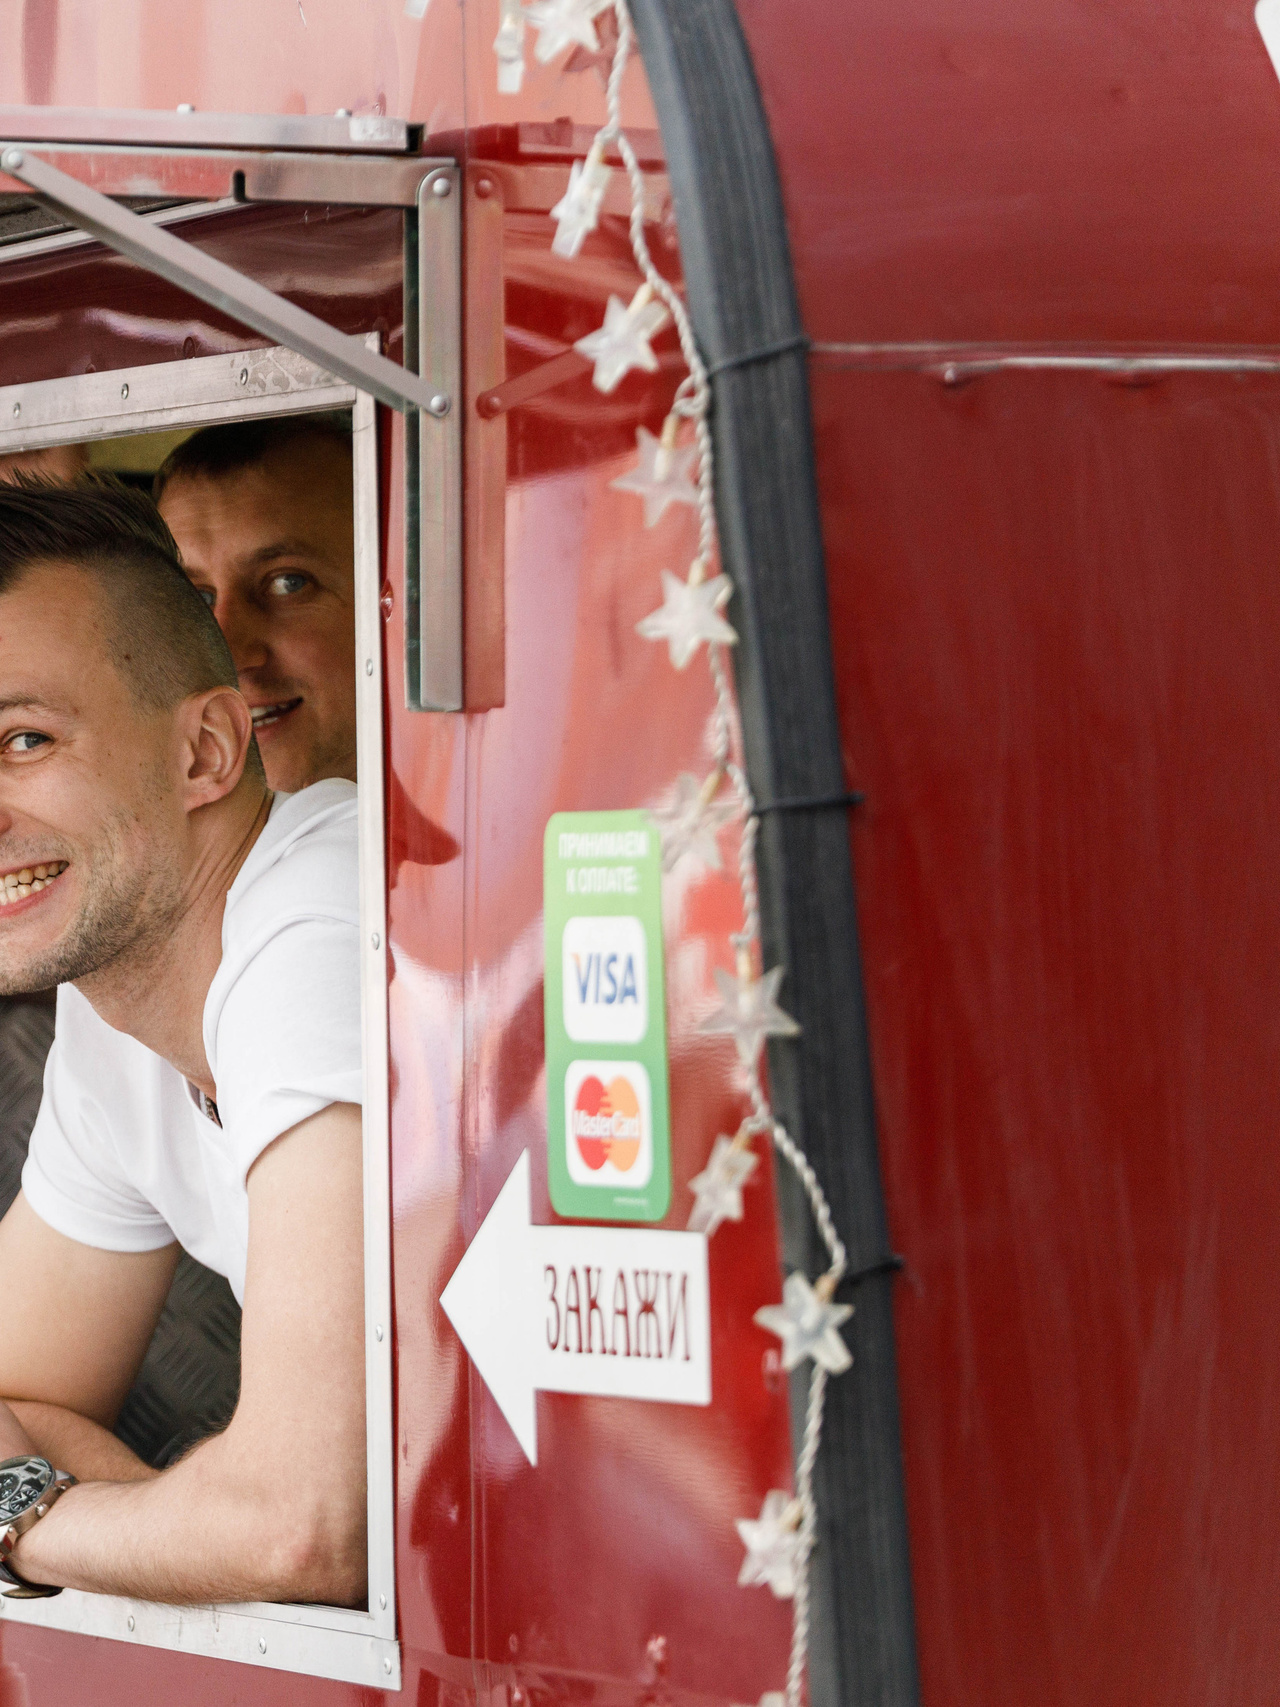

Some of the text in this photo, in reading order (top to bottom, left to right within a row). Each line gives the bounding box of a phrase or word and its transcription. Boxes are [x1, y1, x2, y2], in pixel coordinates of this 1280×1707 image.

[572, 953, 638, 1004] VISA
[573, 1109, 641, 1138] MasterCard
[544, 1264, 690, 1361] ЗАКАЖИ
